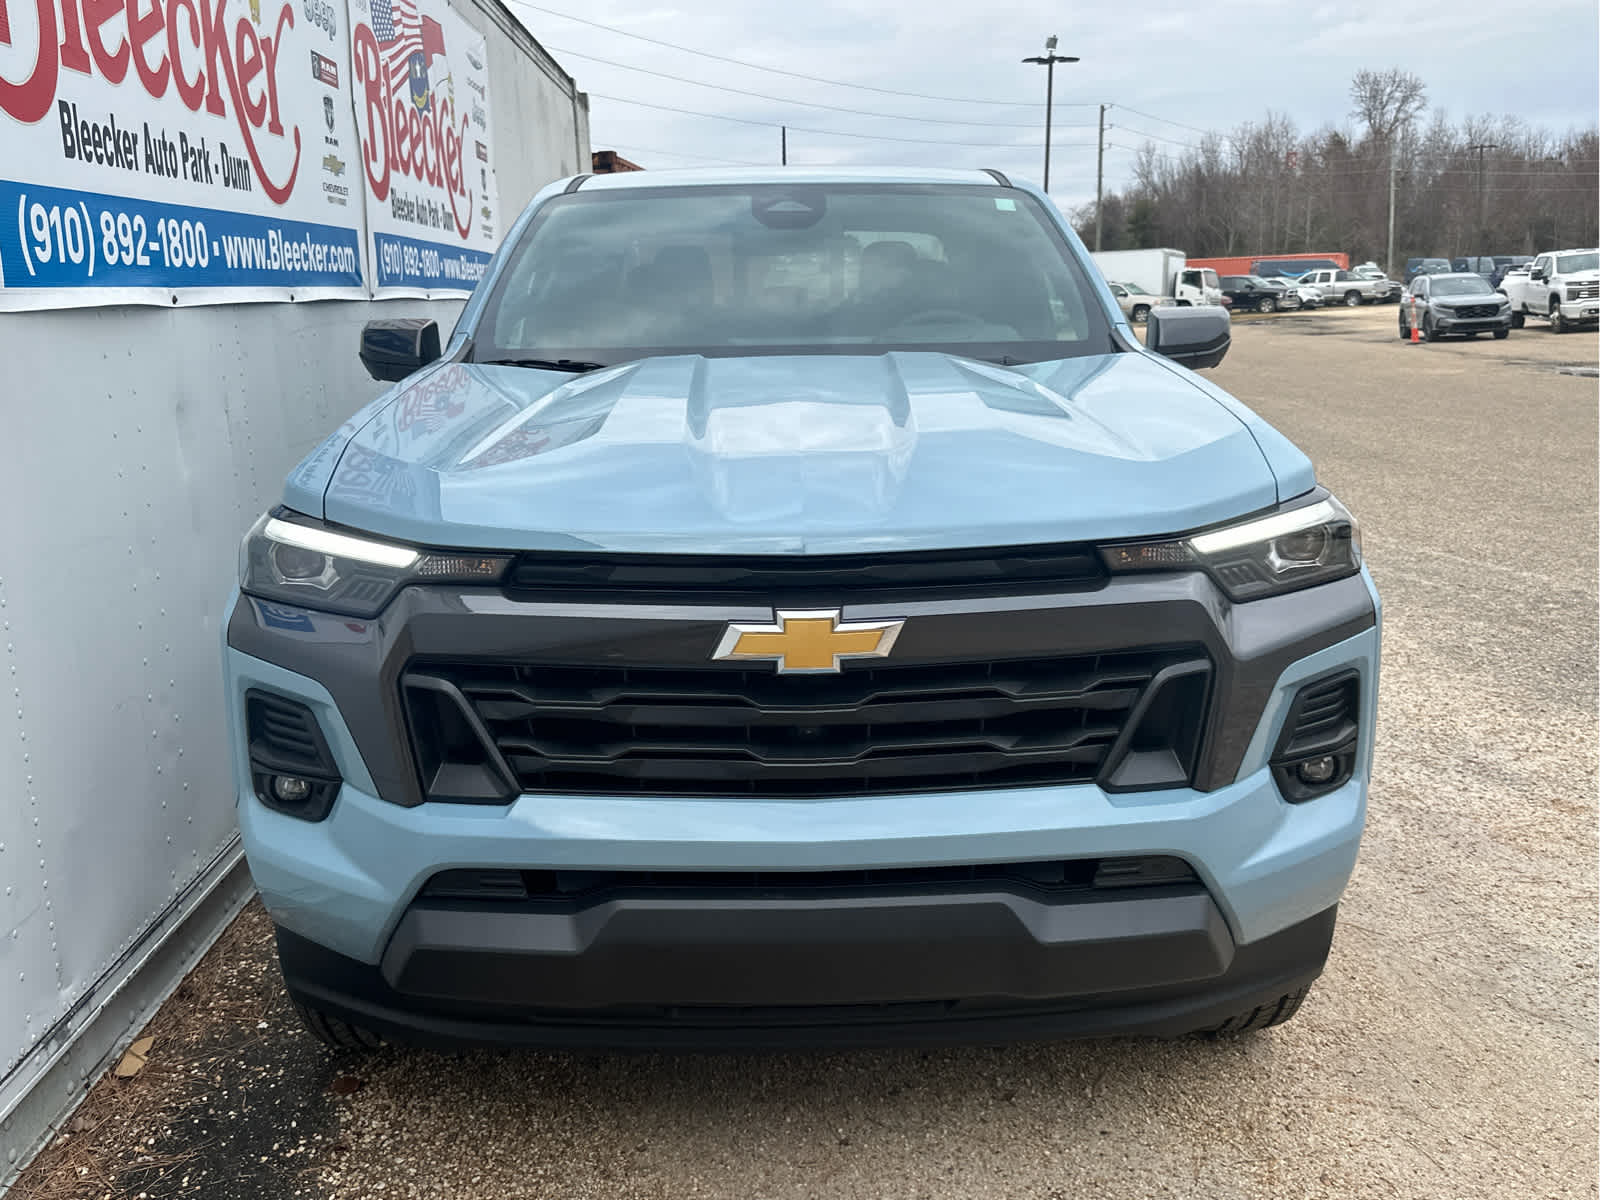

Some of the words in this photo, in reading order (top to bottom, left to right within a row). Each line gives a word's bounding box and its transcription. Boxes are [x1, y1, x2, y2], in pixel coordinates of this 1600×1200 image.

[0, 0, 301, 205] eecker
[324, 136, 339, 147] RAM
[352, 22, 473, 240] Bleecker
[58, 99, 139, 171] Bleecker
[143, 122, 178, 179] Auto
[179, 131, 213, 185] Park
[219, 142, 252, 192] Dunn
[18, 194, 94, 277] (910)
[99, 210, 209, 269] 892-1800
[221, 228, 356, 273] www.Bleecker.com
[390, 187, 415, 223] Bleecker
[380, 238, 404, 281] (910)
[403, 244, 440, 278] 892-1800
